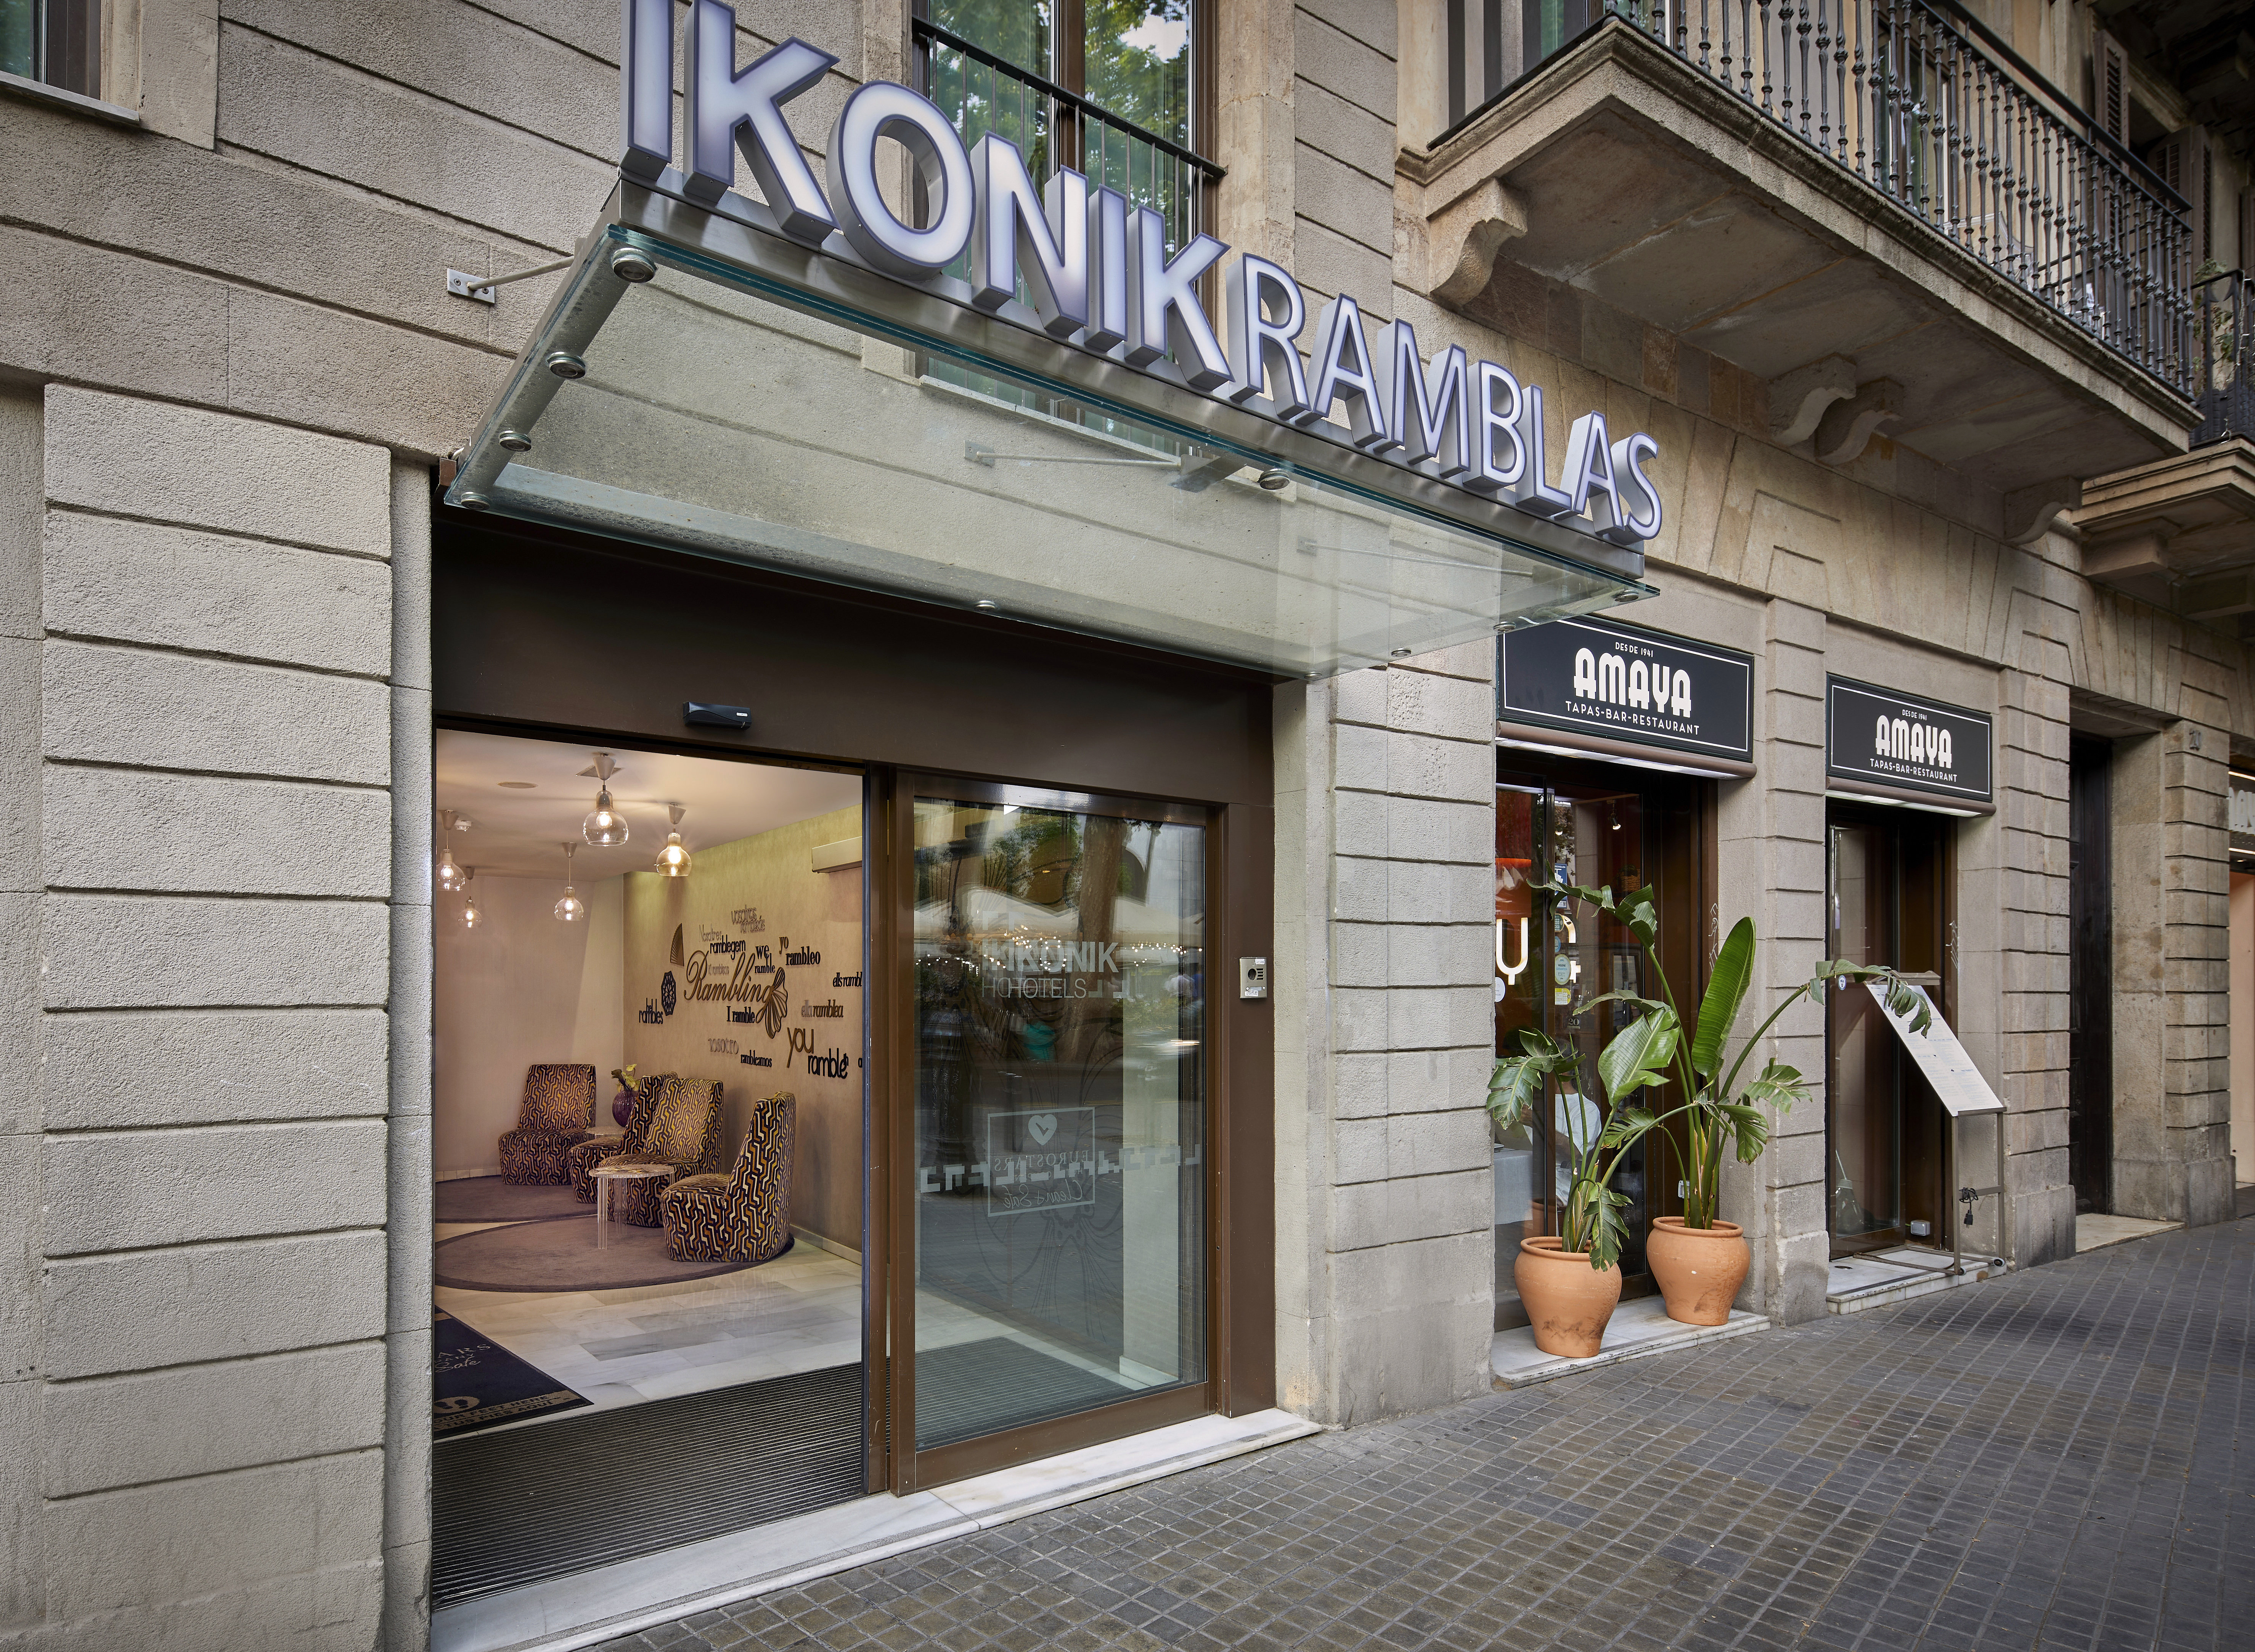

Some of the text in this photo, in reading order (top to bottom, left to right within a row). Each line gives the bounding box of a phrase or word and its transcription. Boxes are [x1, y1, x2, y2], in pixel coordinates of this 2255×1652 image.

[621, 0, 1662, 544] IKONIK RAMBLAS
[1615, 642, 1654, 658] DESDE 1941
[1574, 647, 1692, 718] AMAYA
[1902, 709, 1927, 721] DESDE 1941
[1875, 715, 1952, 769] AMAYA
[710, 934, 746, 960] ramblegem
[755, 945, 769, 960] we
[779, 936, 789, 954] yo
[754, 953, 776, 974] ramble
[785, 946, 821, 965] rambleo
[1009, 939, 1119, 973] IKONIK
[1008, 978, 1087, 999] HOTELS
[732, 1006, 755, 1023] ramble
[813, 999, 843, 1018] ramblea
[787, 1027, 814, 1068] you
[740, 1049, 772, 1068] rambleamos
